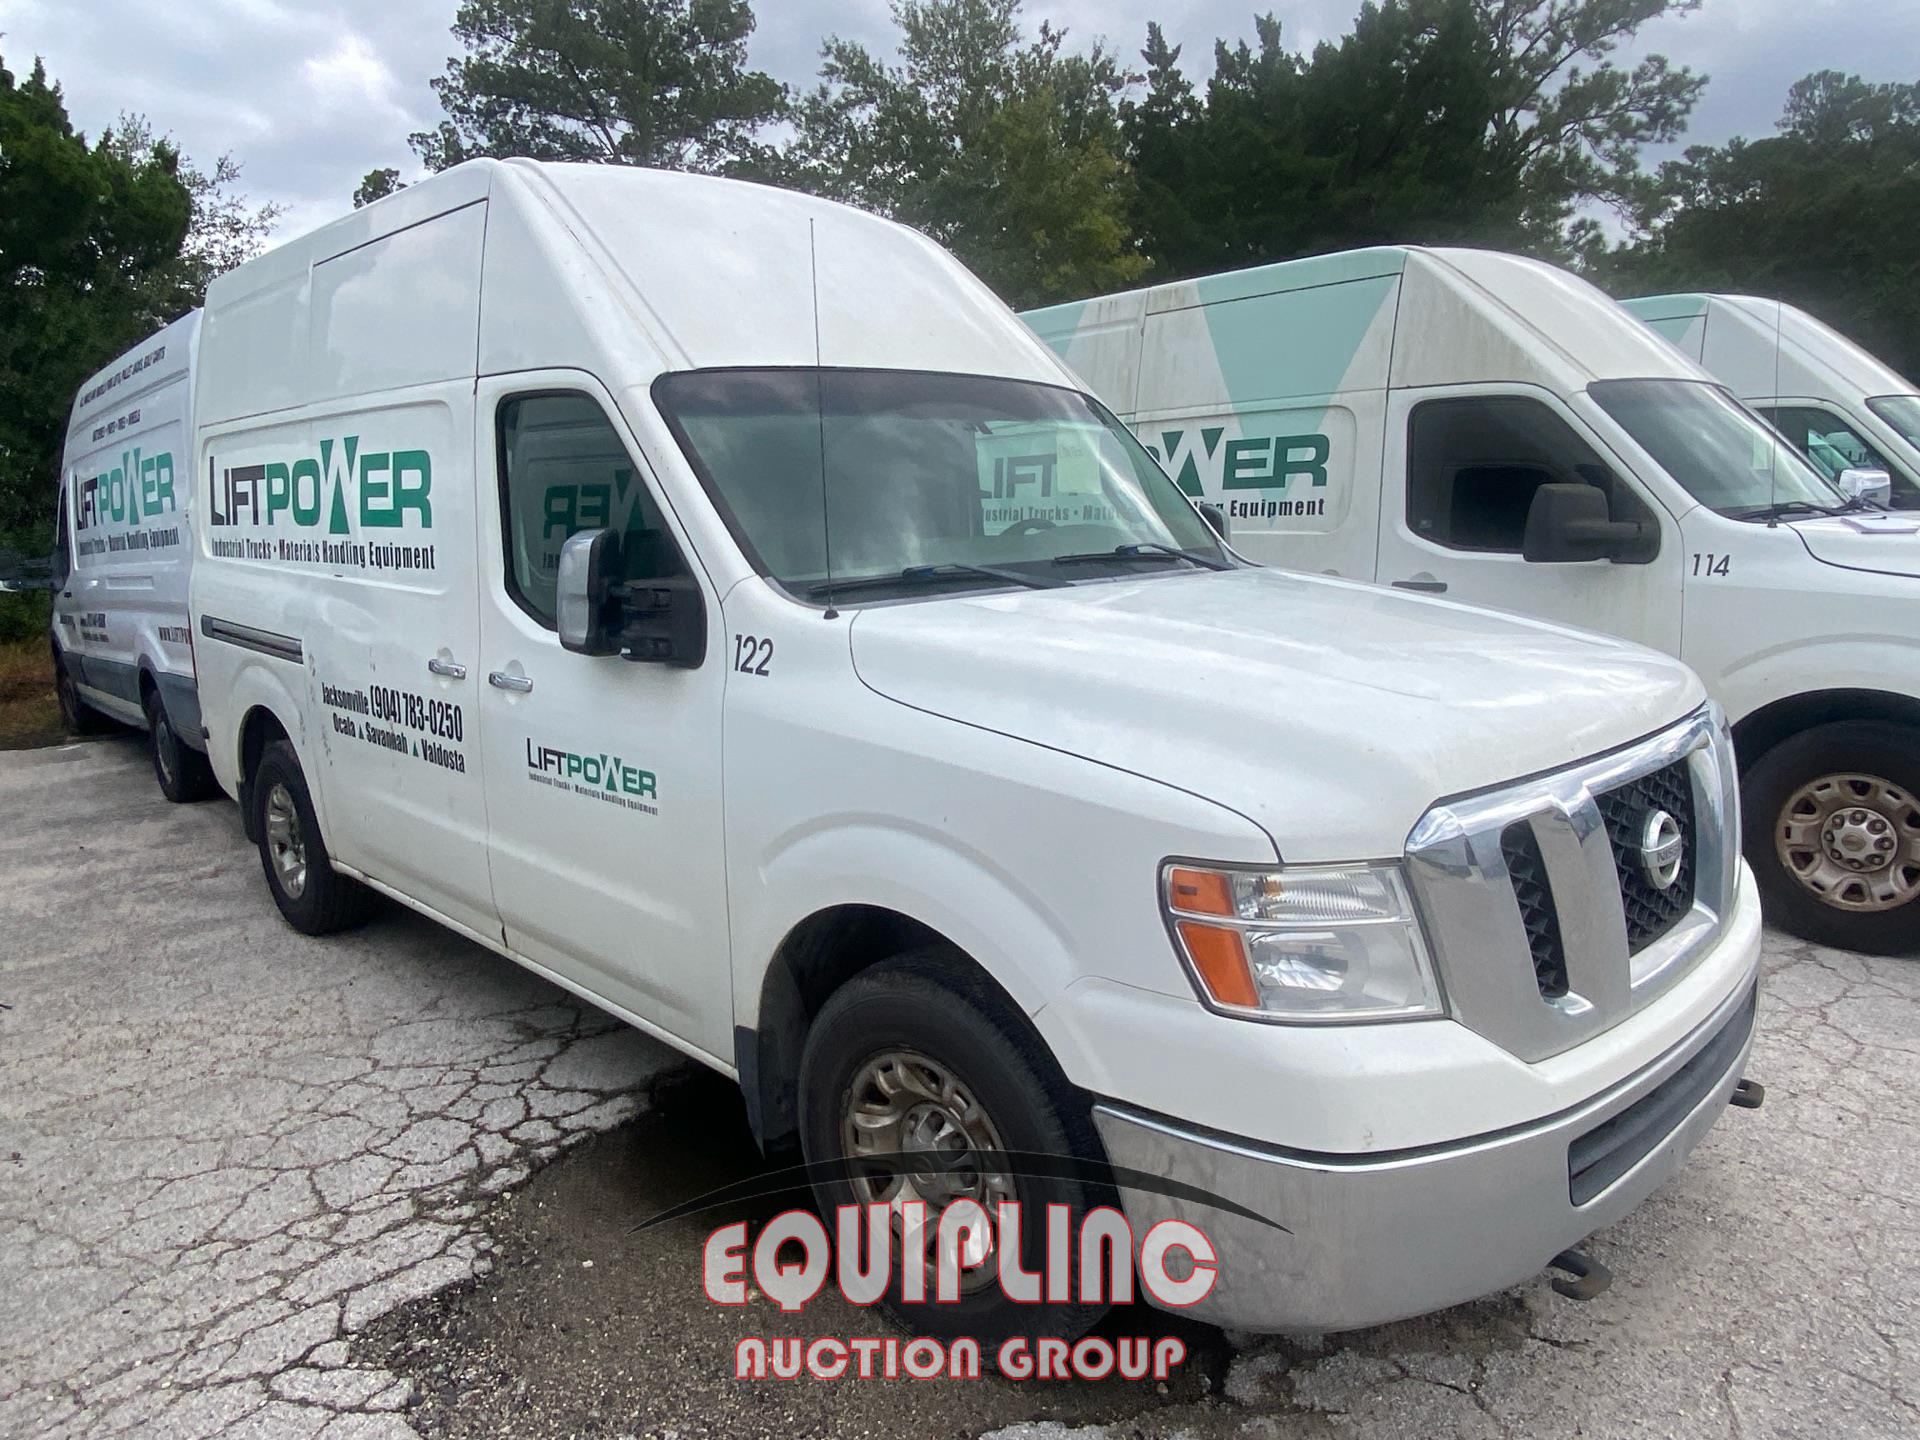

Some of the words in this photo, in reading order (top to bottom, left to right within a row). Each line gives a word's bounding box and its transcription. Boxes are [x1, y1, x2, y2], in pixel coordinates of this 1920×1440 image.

[75, 447, 176, 530] LIFTPOWER
[209, 435, 433, 535] LIFTPOWER
[982, 506, 1023, 522] ustrial
[1028, 506, 1069, 521] Trucks
[1230, 498, 1325, 520] Equipment
[211, 537, 245, 558] Industrial
[246, 538, 271, 560] Trucks
[279, 538, 320, 563] Materials
[322, 540, 366, 569] Handling
[369, 541, 436, 570] Equipment
[1692, 553, 1731, 577] 114
[735, 633, 774, 677] 122
[321, 681, 369, 716] Jacksonville
[370, 684, 402, 724] (904)
[402, 692, 463, 743] 783-0250
[332, 711, 357, 738] Ocala
[365, 721, 409, 755] Savannah
[421, 738, 466, 774] Valdosta
[526, 736, 657, 800] LIFTPOWER
[601, 790, 627, 808] Handling
[627, 797, 659, 816] Equipment
